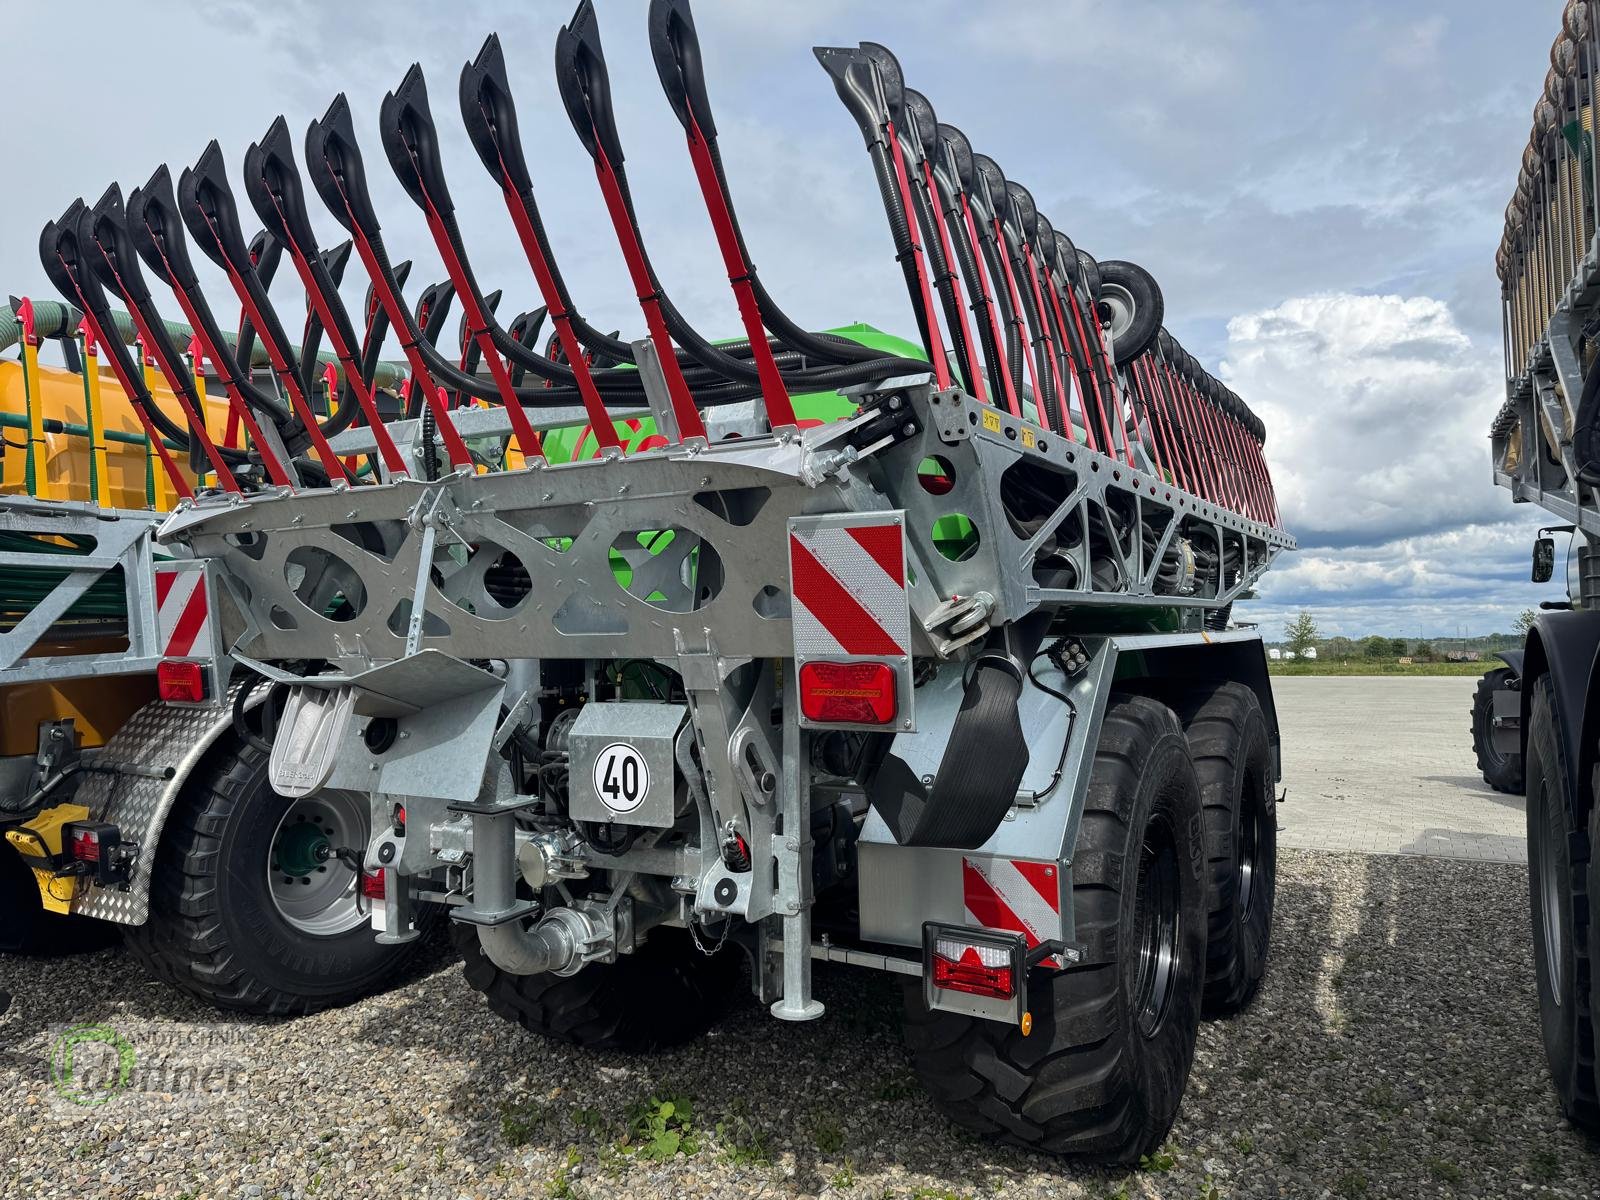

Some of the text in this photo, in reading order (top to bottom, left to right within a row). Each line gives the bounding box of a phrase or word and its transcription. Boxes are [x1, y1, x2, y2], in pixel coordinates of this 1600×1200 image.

[602, 755, 639, 801] 40
[1189, 811, 1204, 882] BKT
[1023, 918, 1038, 934] GEKA
